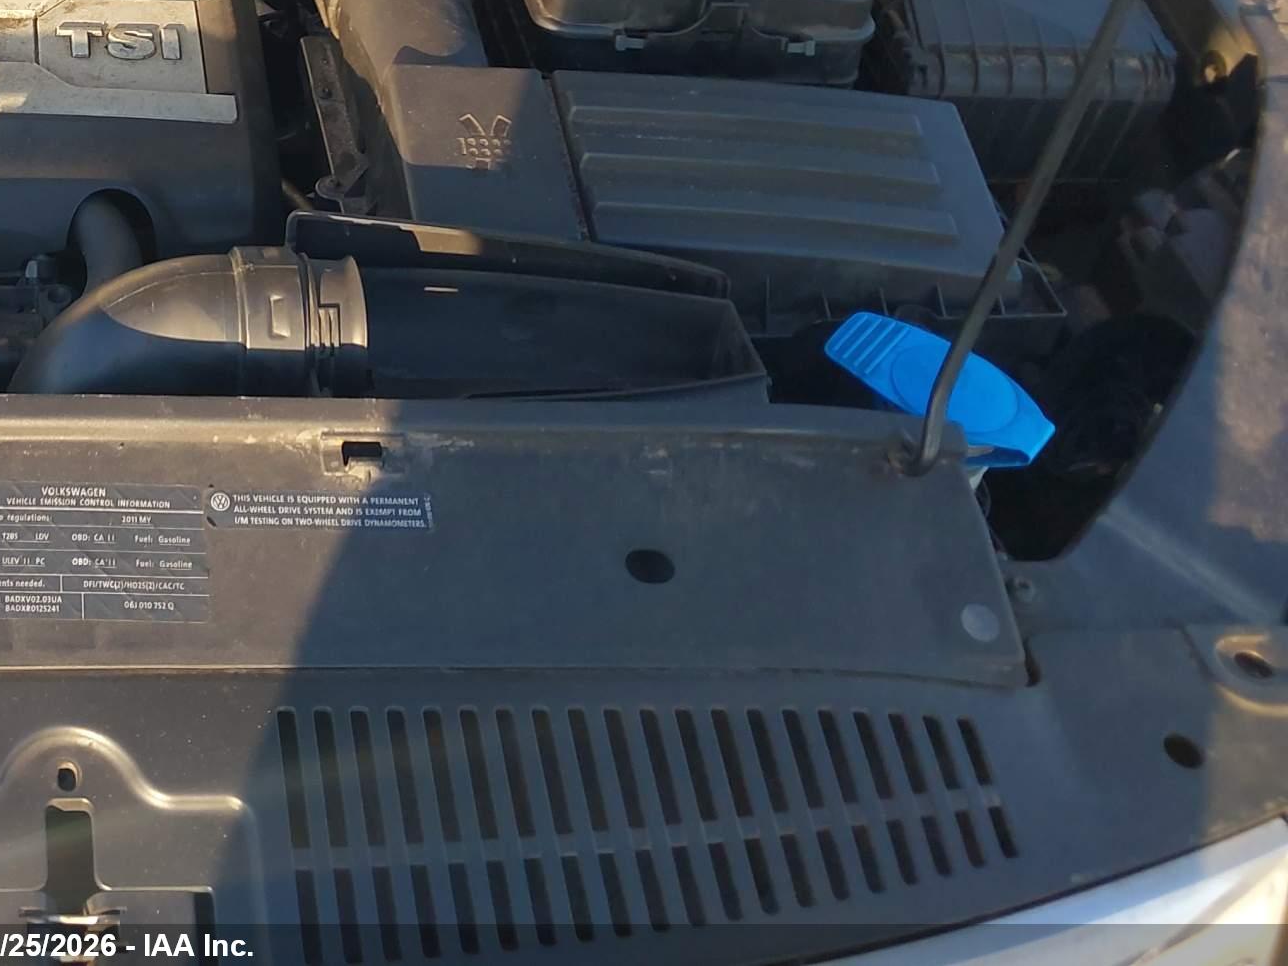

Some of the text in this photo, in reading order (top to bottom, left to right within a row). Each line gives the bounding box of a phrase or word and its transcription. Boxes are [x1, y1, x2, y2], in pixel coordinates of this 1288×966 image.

[55, 21, 184, 60] TSI
[41, 487, 106, 497] VOLKSWAGEN
[7, 497, 170, 508] VEHICLE EMISSION CONTROL INFORMATION
[233, 494, 419, 506] THIS VEHICLE IS EQUIPPED WITH A PERMANENT
[234, 505, 422, 517] ALL-WHEEL DRIVE SYSTEM AND IS EXEMPT FROM
[234, 516, 427, 529] I/M TESTING ON TWO-WHEEL DRIVE DYNAMOMETERS.
[71, 534, 90, 542] OBD:
[135, 535, 191, 544] Fuel: Gasoline
[72, 558, 91, 566] OBD:
[95, 558, 105, 566] CA
[136, 559, 192, 569] Fuel: Gasoline
[15, 579, 45, 587] needed.
[139, 602, 153, 610] 010
[154, 602, 167, 610] 752
[168, 602, 175, 611] Q
